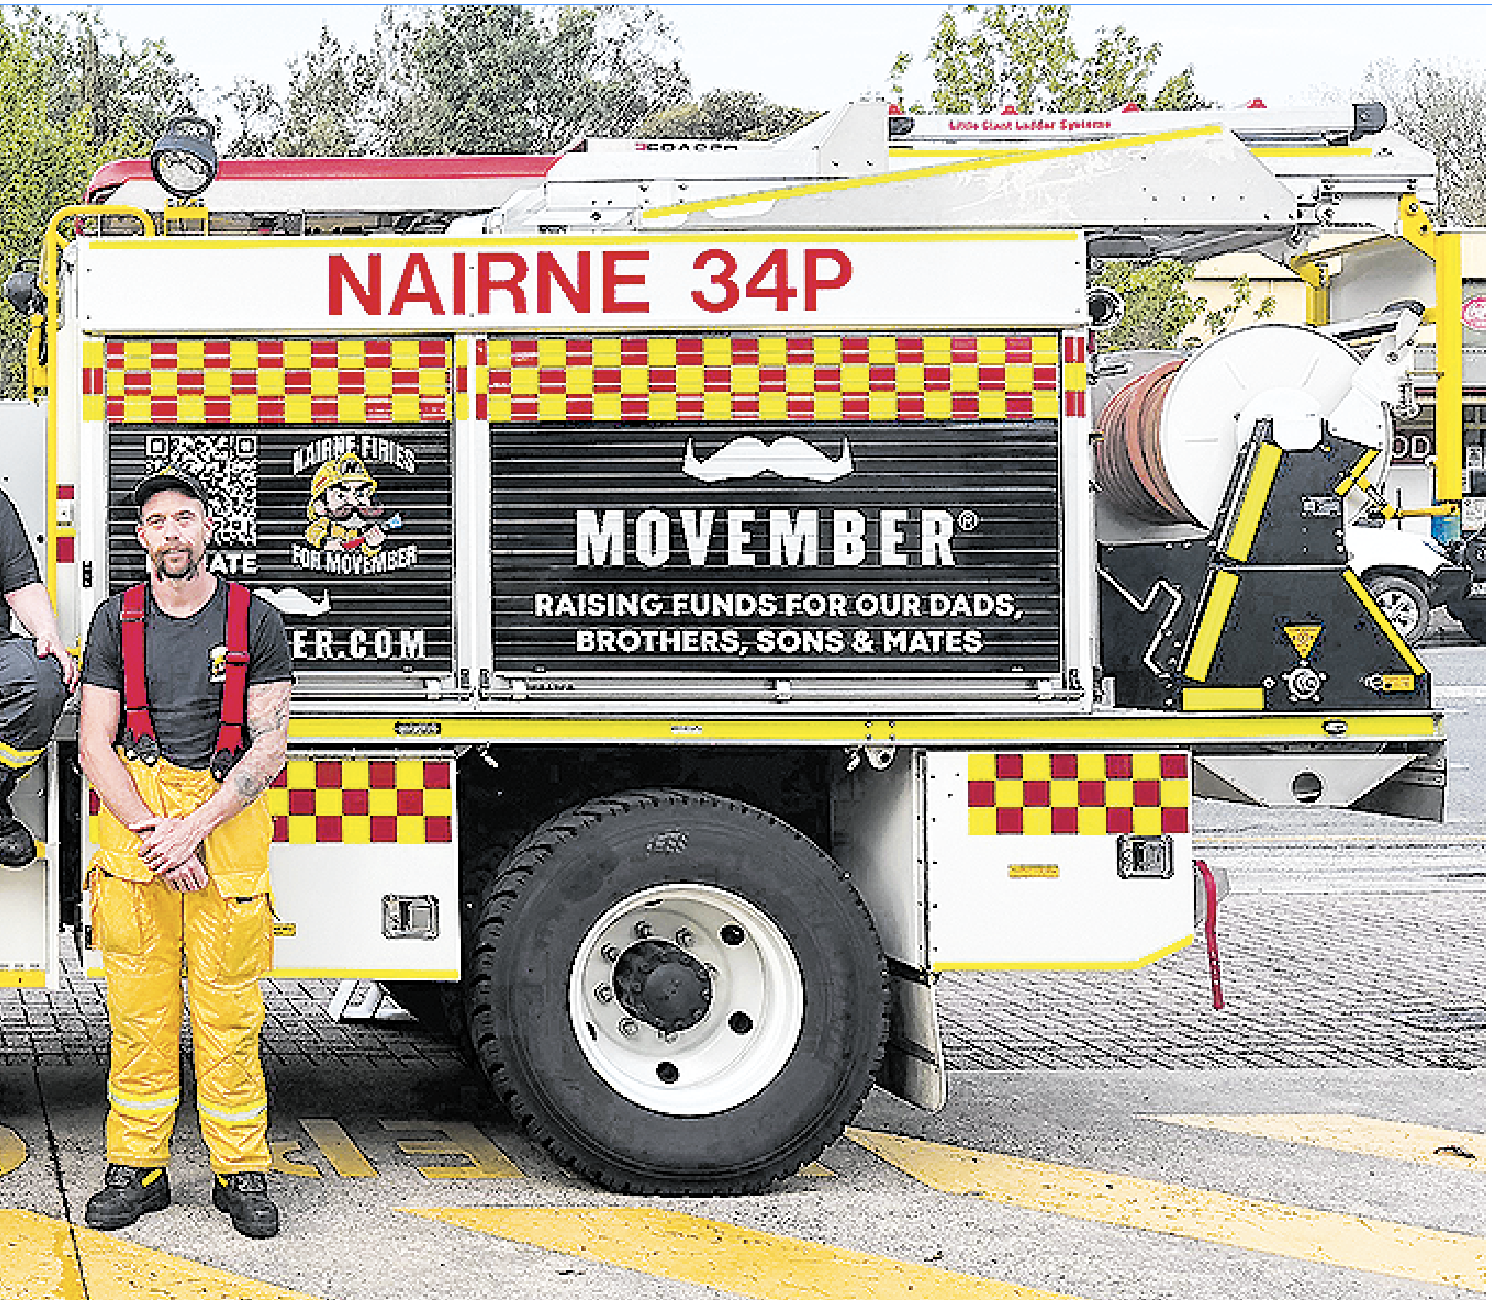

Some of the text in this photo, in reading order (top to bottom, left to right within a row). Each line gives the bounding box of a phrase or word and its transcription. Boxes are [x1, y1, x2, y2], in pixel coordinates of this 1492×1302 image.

[328, 249, 853, 316] NAIRNE 34P
[210, 553, 256, 574] ATE
[326, 545, 419, 575] MOVEMBER
[535, 593, 1025, 620] RAISING FUNDS FOR OUR DADS,
[293, 630, 425, 659] ER.COM
[576, 630, 983, 655] BROTHERS, SONS & MATES
